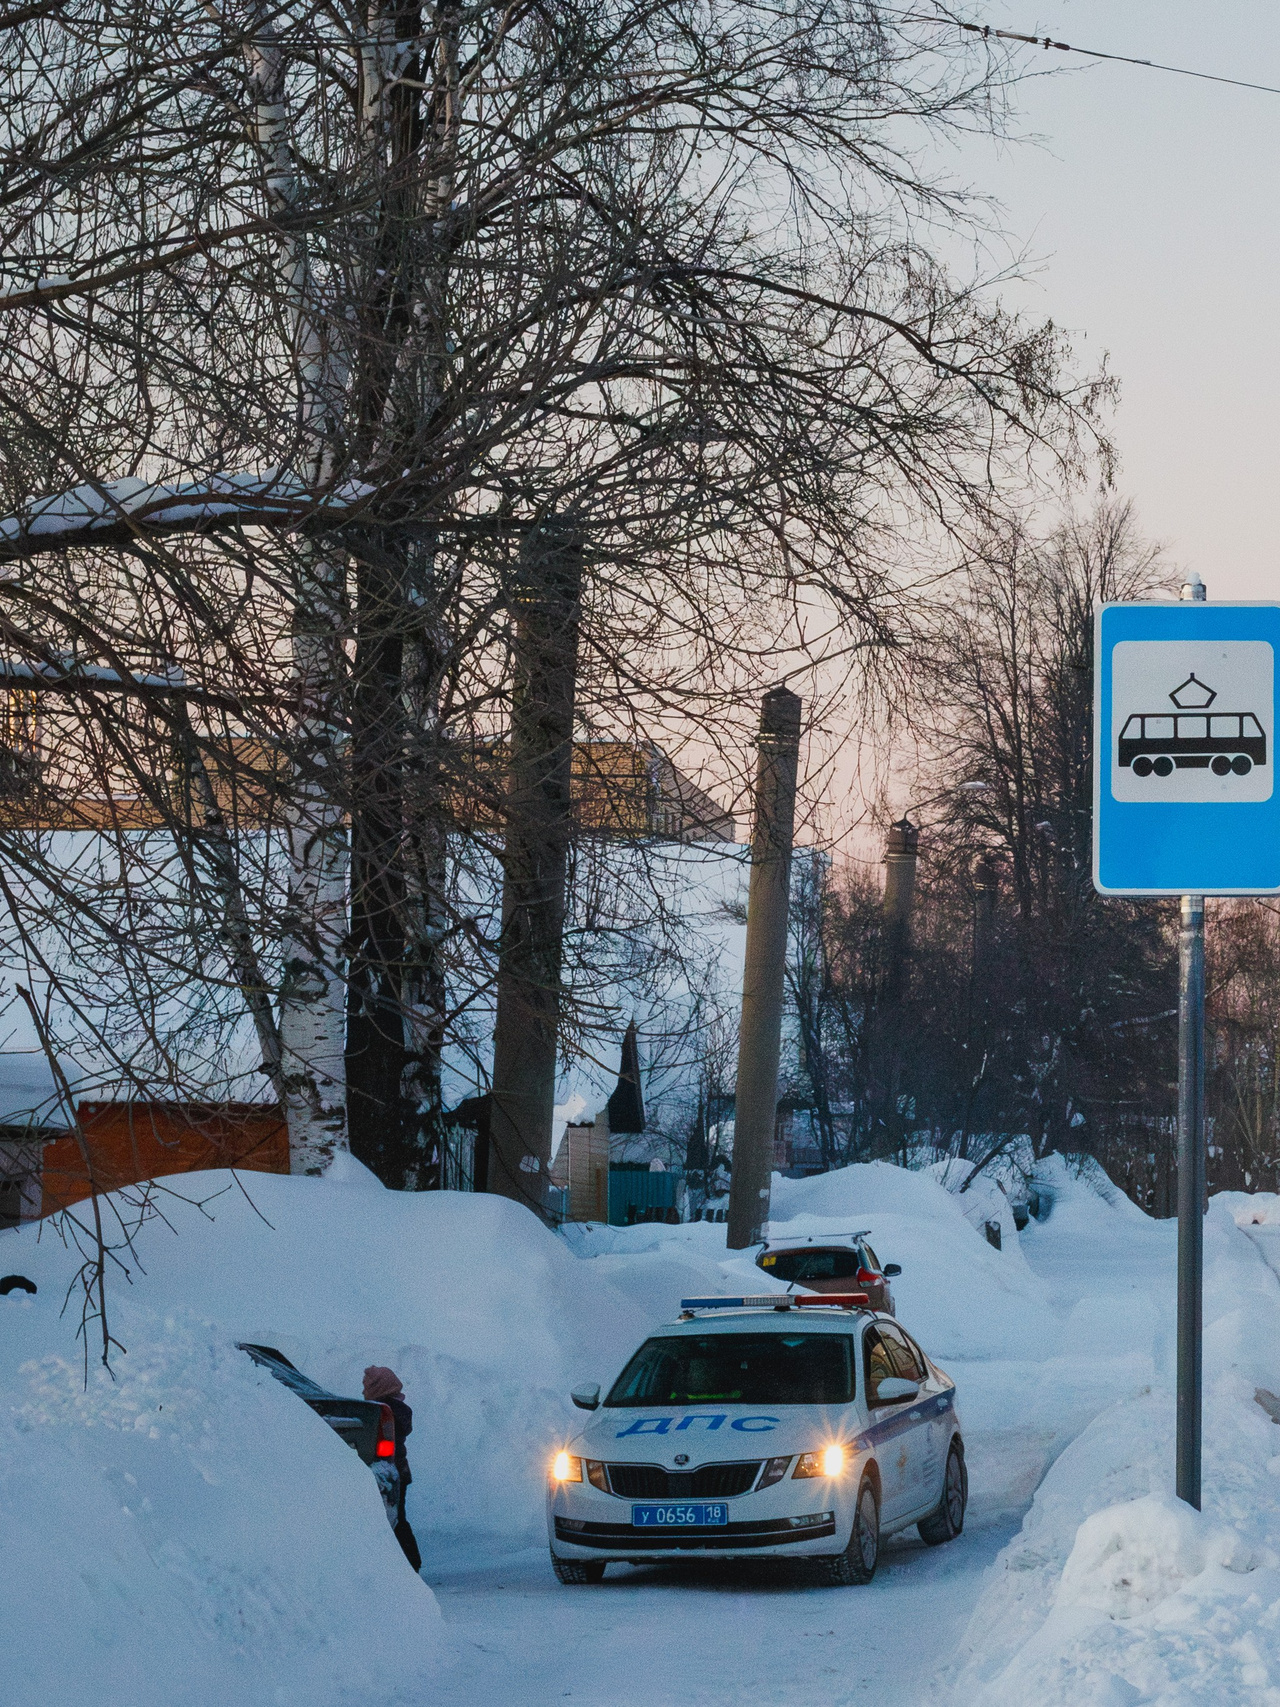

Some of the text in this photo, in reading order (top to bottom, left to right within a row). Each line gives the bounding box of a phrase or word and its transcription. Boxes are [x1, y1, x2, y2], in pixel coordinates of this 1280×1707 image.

[615, 1414, 781, 1439] ДПС
[656, 1507, 696, 1523] 0656
[706, 1506, 721, 1518] 18
